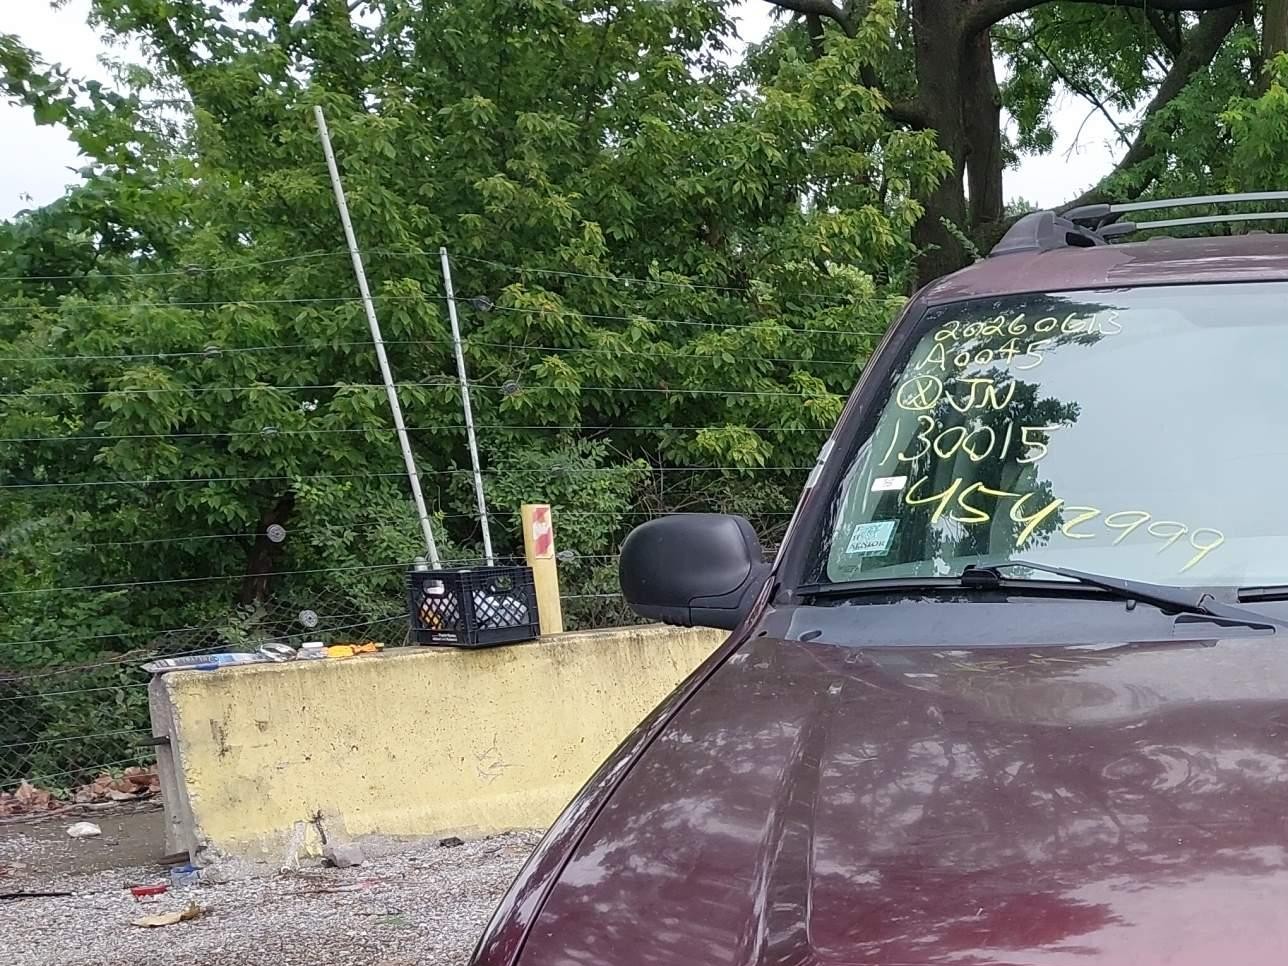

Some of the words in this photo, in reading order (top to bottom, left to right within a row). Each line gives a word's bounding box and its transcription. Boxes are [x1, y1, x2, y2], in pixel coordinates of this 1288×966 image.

[934, 309, 1122, 342] 20260613
[916, 338, 1052, 372] A0045
[879, 415, 1059, 465] 130015
[905, 474, 1225, 574] 4542999
